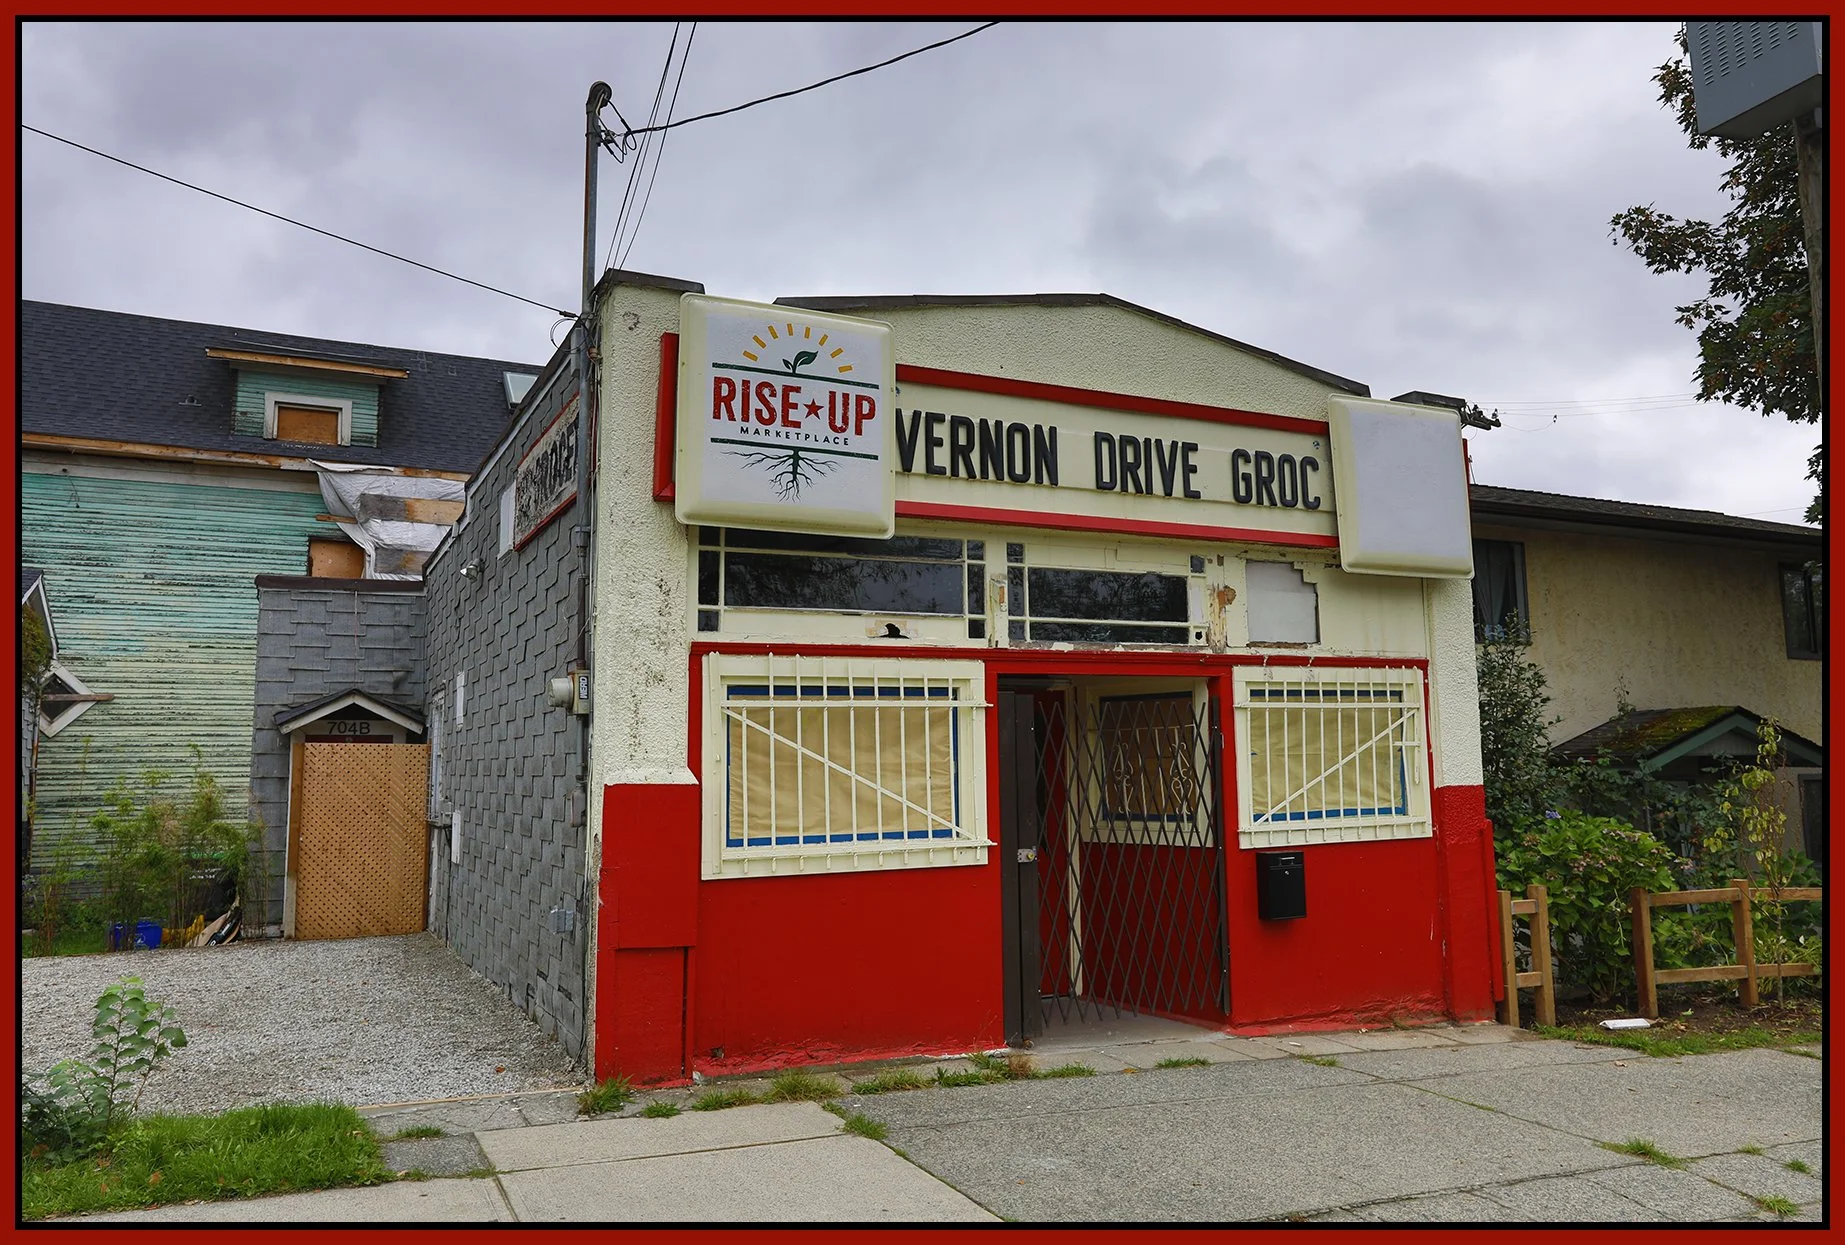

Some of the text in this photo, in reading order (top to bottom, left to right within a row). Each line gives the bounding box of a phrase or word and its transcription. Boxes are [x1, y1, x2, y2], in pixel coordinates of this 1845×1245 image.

[713, 376, 876, 436] RISE UP
[740, 426, 849, 446] MARKETPLACE
[896, 408, 1321, 510] VERNON DRIVE GROC
[327, 721, 370, 735] 704B
